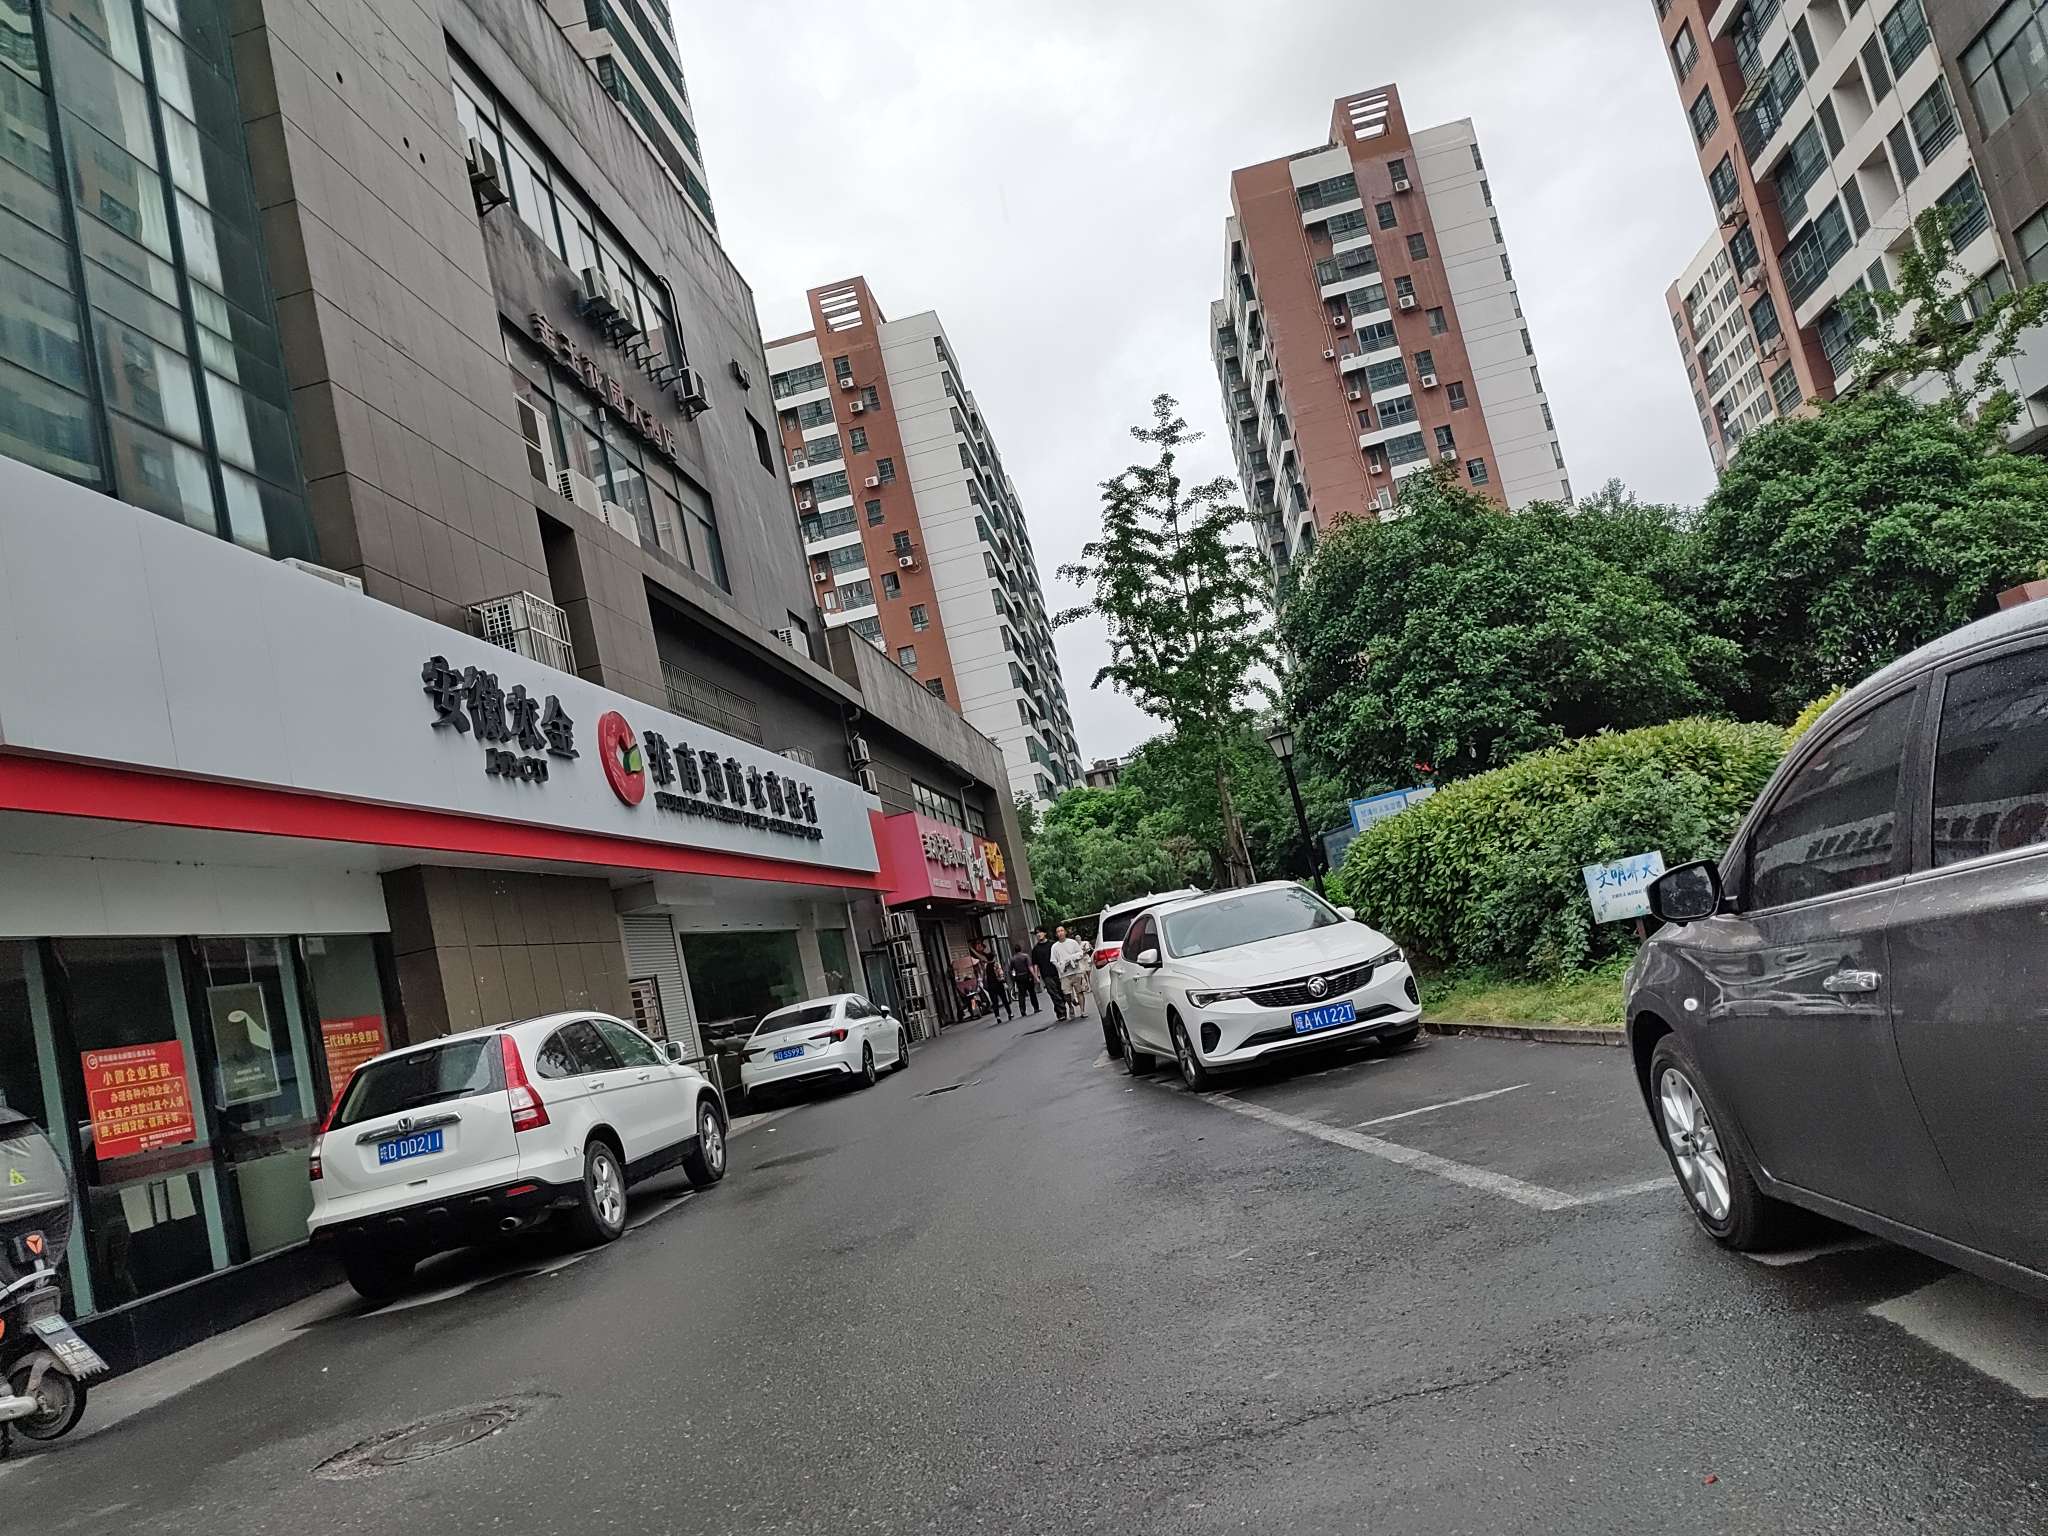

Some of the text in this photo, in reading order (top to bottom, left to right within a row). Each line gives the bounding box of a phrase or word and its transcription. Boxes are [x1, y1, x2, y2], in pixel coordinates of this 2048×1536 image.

[642, 730, 819, 825] 淮南通商农商银行
